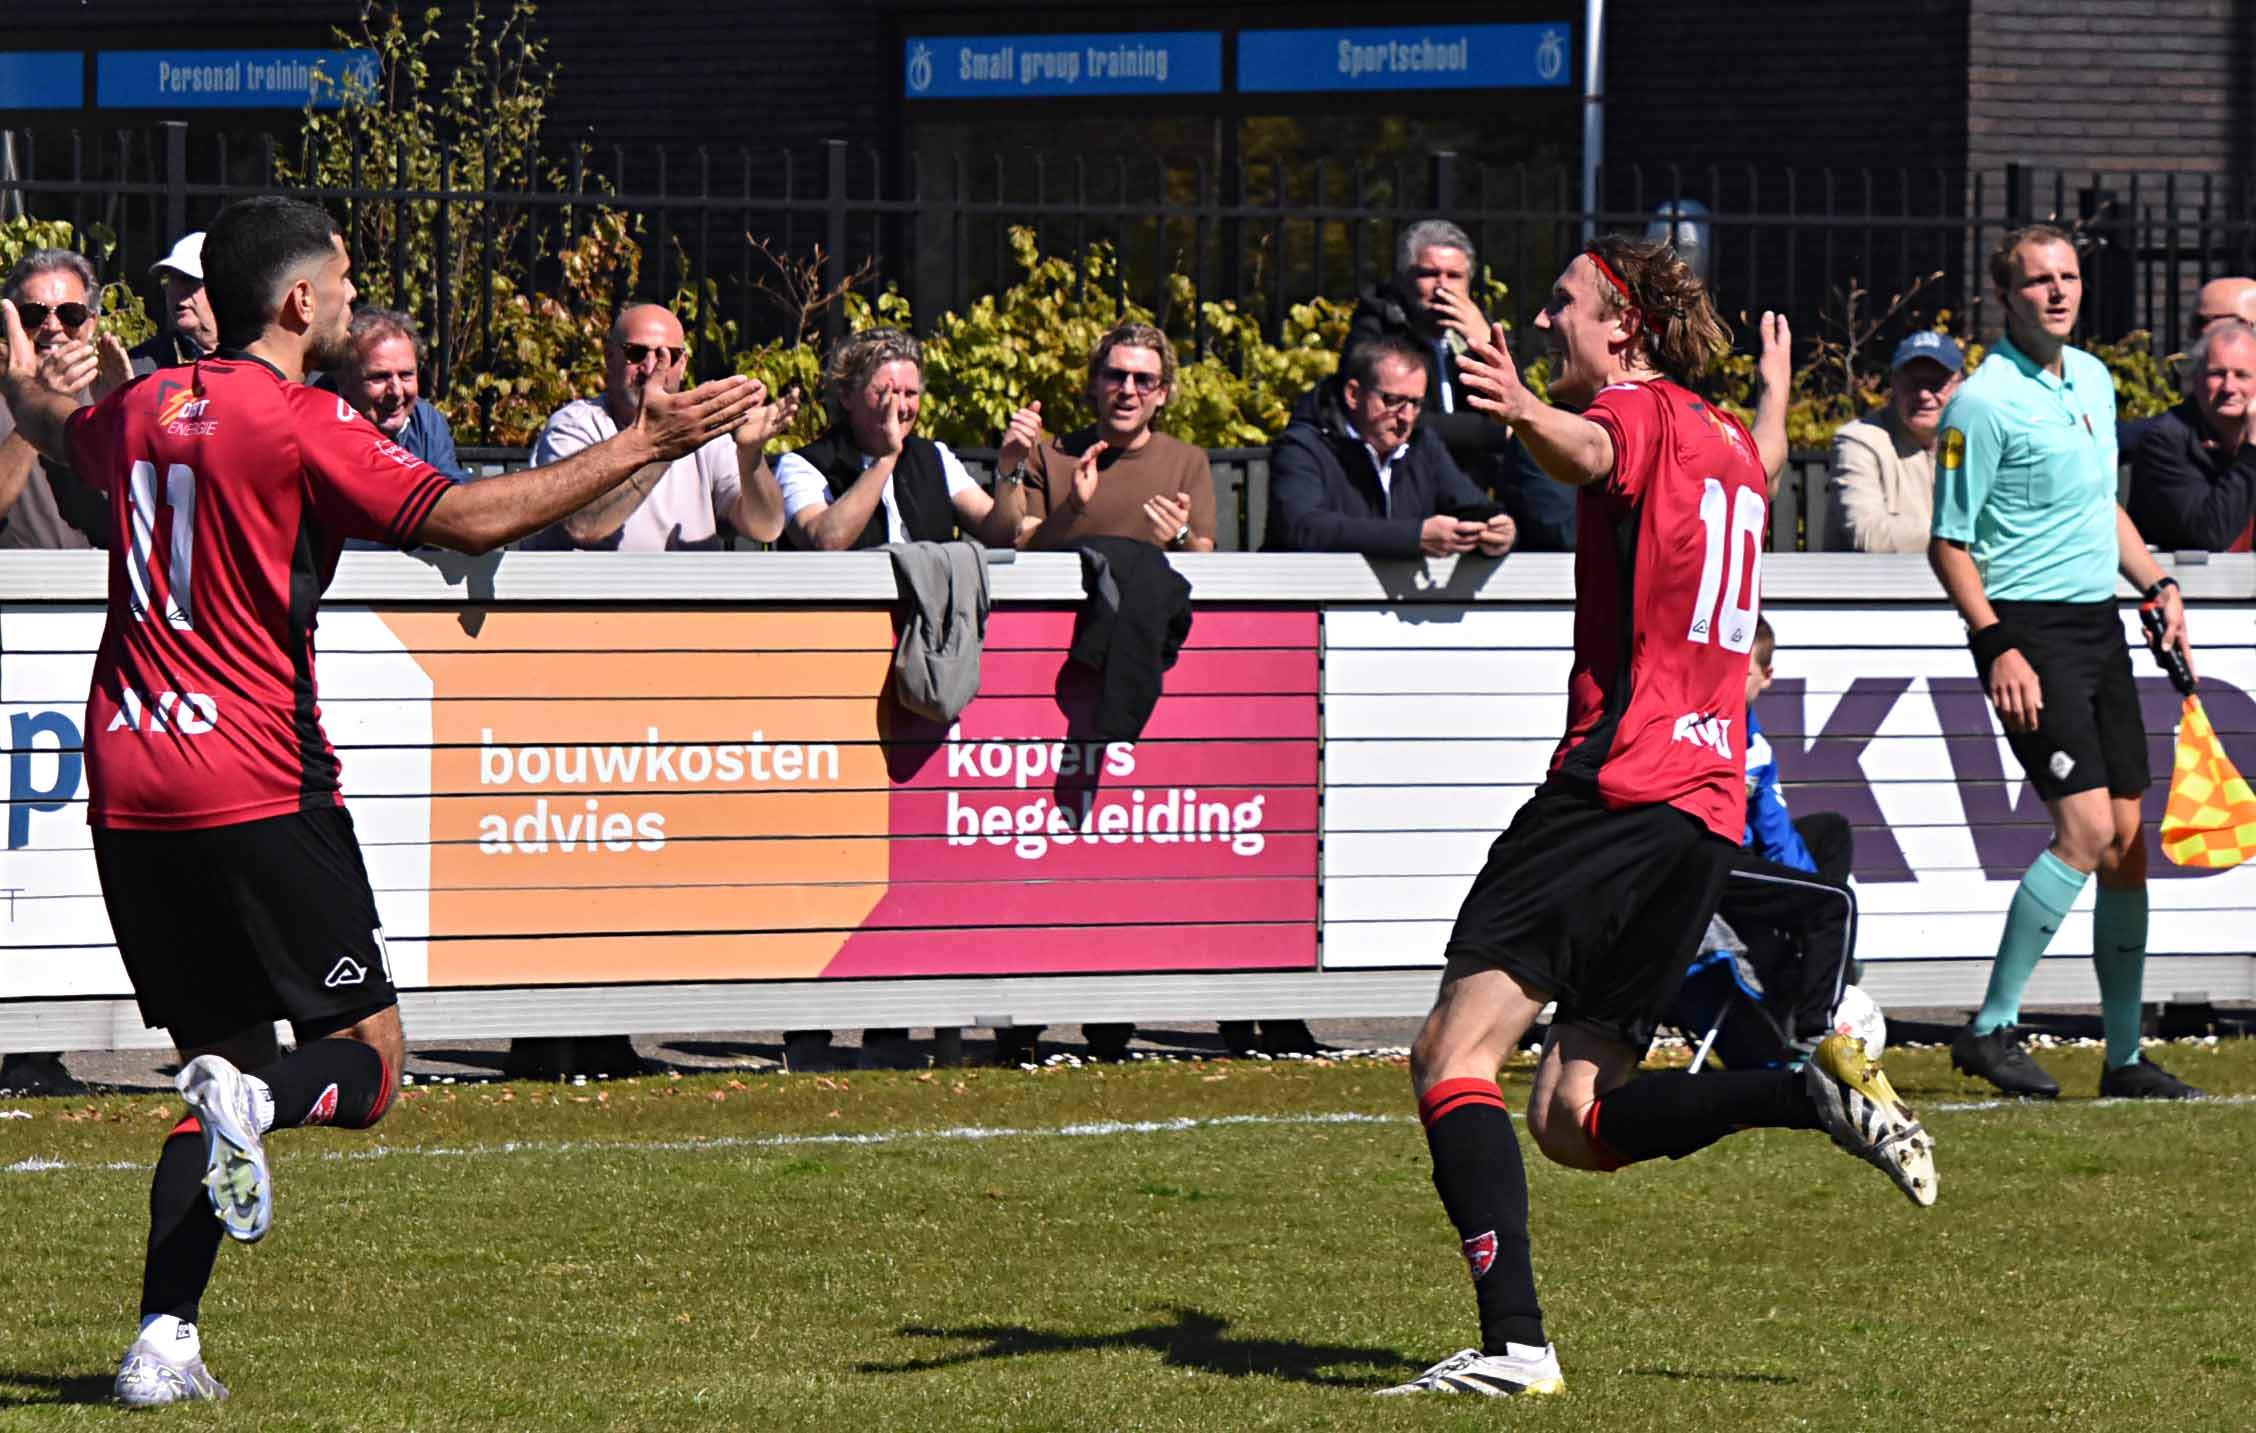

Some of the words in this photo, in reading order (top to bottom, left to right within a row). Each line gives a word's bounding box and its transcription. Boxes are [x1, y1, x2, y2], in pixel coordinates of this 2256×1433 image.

[159, 60, 241, 92] Personal
[960, 47, 1014, 80] Small
[1020, 51, 1080, 84] group
[1086, 44, 1168, 81] training
[1337, 37, 1468, 77] Sportschool
[127, 458, 196, 631] 11
[1687, 477, 1766, 654] 10
[479, 726, 840, 785] bouwkosten
[946, 722, 1137, 789] kopers
[478, 798, 667, 855] advies
[946, 788, 1267, 860] begeleiding
